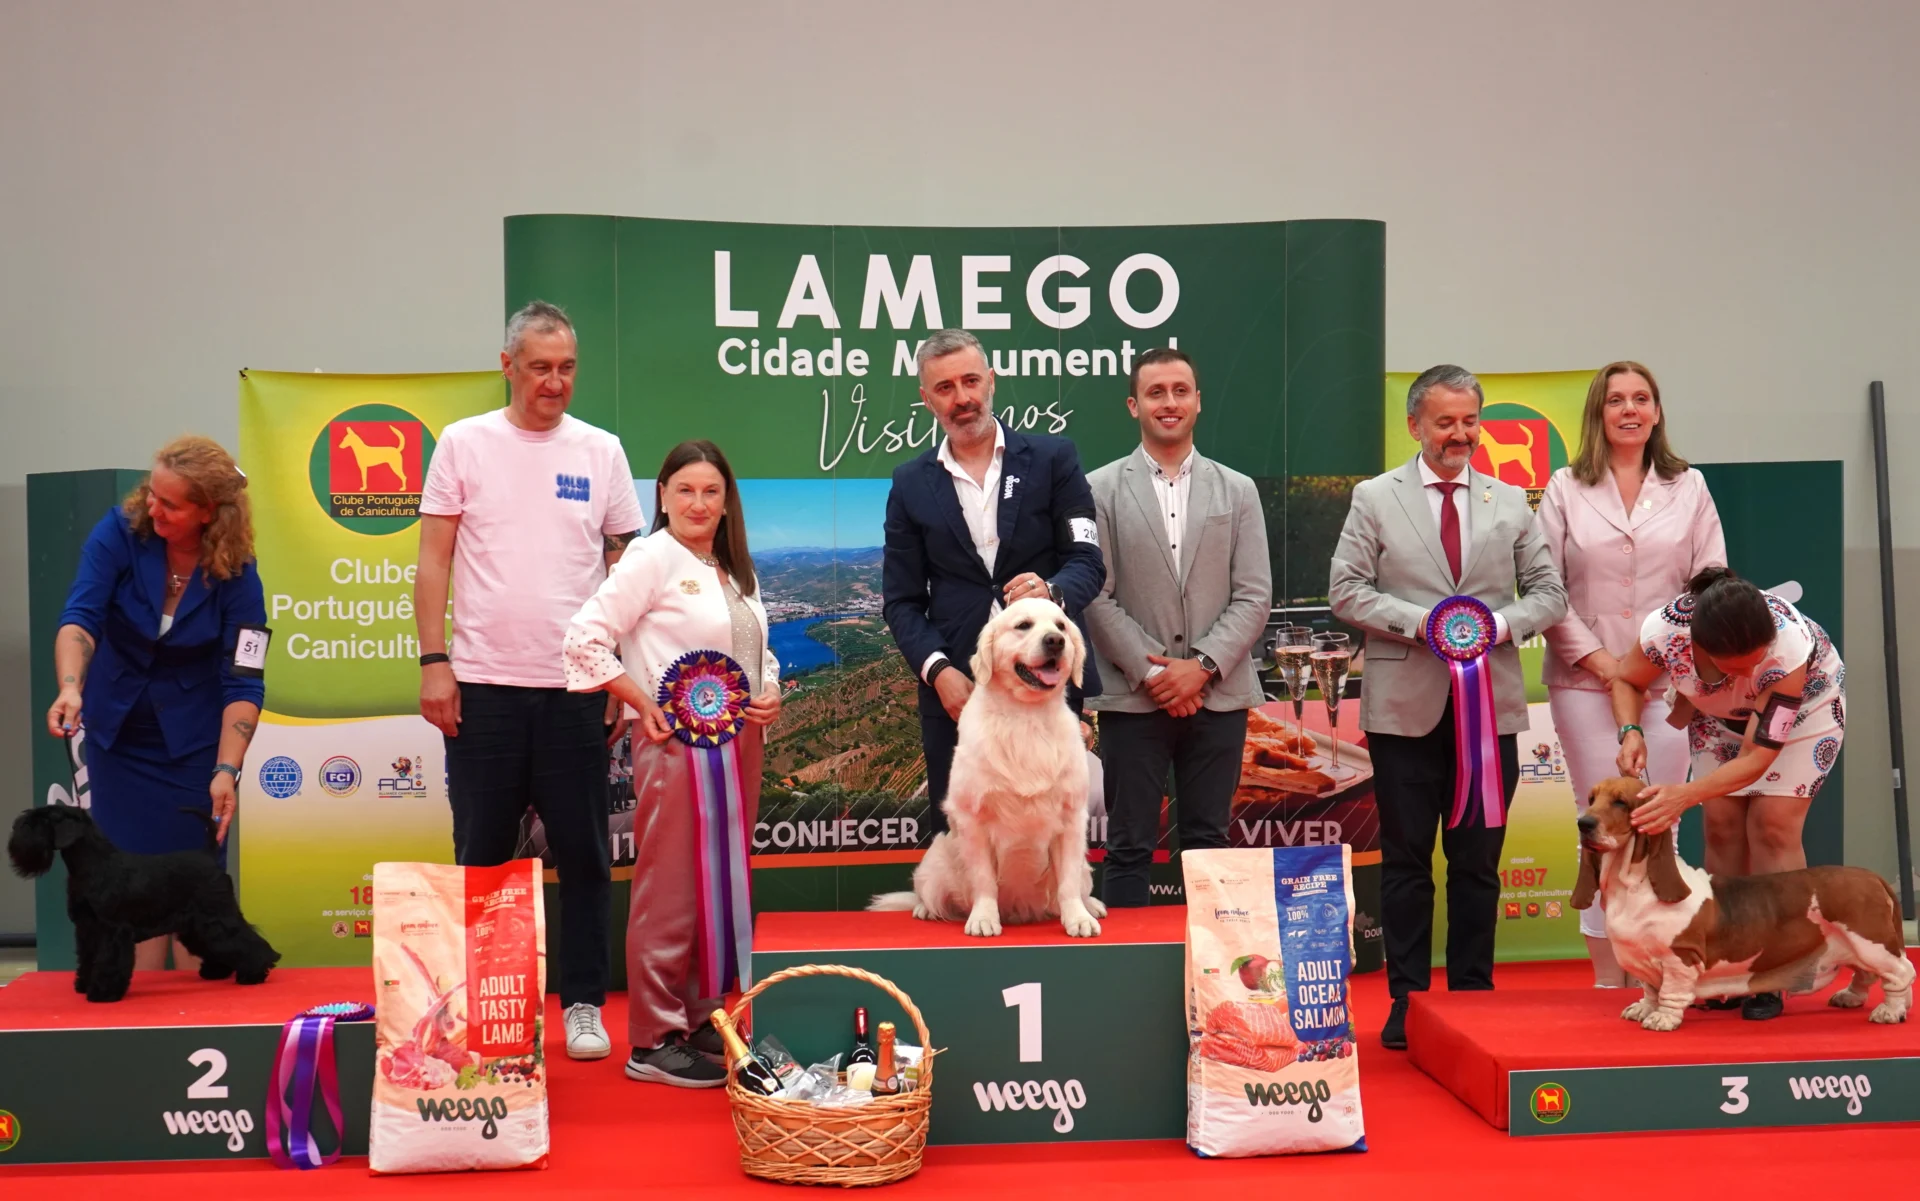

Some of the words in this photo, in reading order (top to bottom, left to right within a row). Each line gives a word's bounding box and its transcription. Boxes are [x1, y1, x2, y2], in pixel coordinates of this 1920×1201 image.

[714, 250, 1180, 329] LAMEGO
[718, 337, 869, 376] Cidade
[333, 495, 364, 505] Clube
[367, 495, 420, 506] Português
[340, 507, 354, 516] de
[357, 507, 416, 516] Canicultura
[330, 558, 418, 584] Clube
[271, 594, 414, 627] Portuguê
[244, 641, 258, 655] 51
[286, 633, 421, 660] Canicult
[330, 773, 351, 782] FCI
[1520, 764, 1565, 776] ACL
[377, 778, 427, 791] ACL
[752, 817, 919, 848] CONHECER
[1238, 818, 1343, 846] VIVER
[1281, 876, 1310, 885] GRAIN
[1292, 881, 1327, 891] RECIPE
[1500, 868, 1548, 888] 1897
[349, 886, 374, 905] 18
[1500, 891, 1516, 900] viço
[1528, 889, 1573, 898] Canicultura
[335, 909, 366, 918] serviço
[1298, 959, 1342, 982] ADULT
[480, 975, 526, 998] ADULT
[1298, 983, 1341, 1006] OCEAN
[480, 998, 527, 1020] TASTY
[1294, 1004, 1346, 1030] SALMON
[482, 1022, 524, 1045] LAMB
[1002, 982, 1042, 1062] 1
[187, 1048, 228, 1099] 2
[1719, 1076, 1749, 1115] 3
